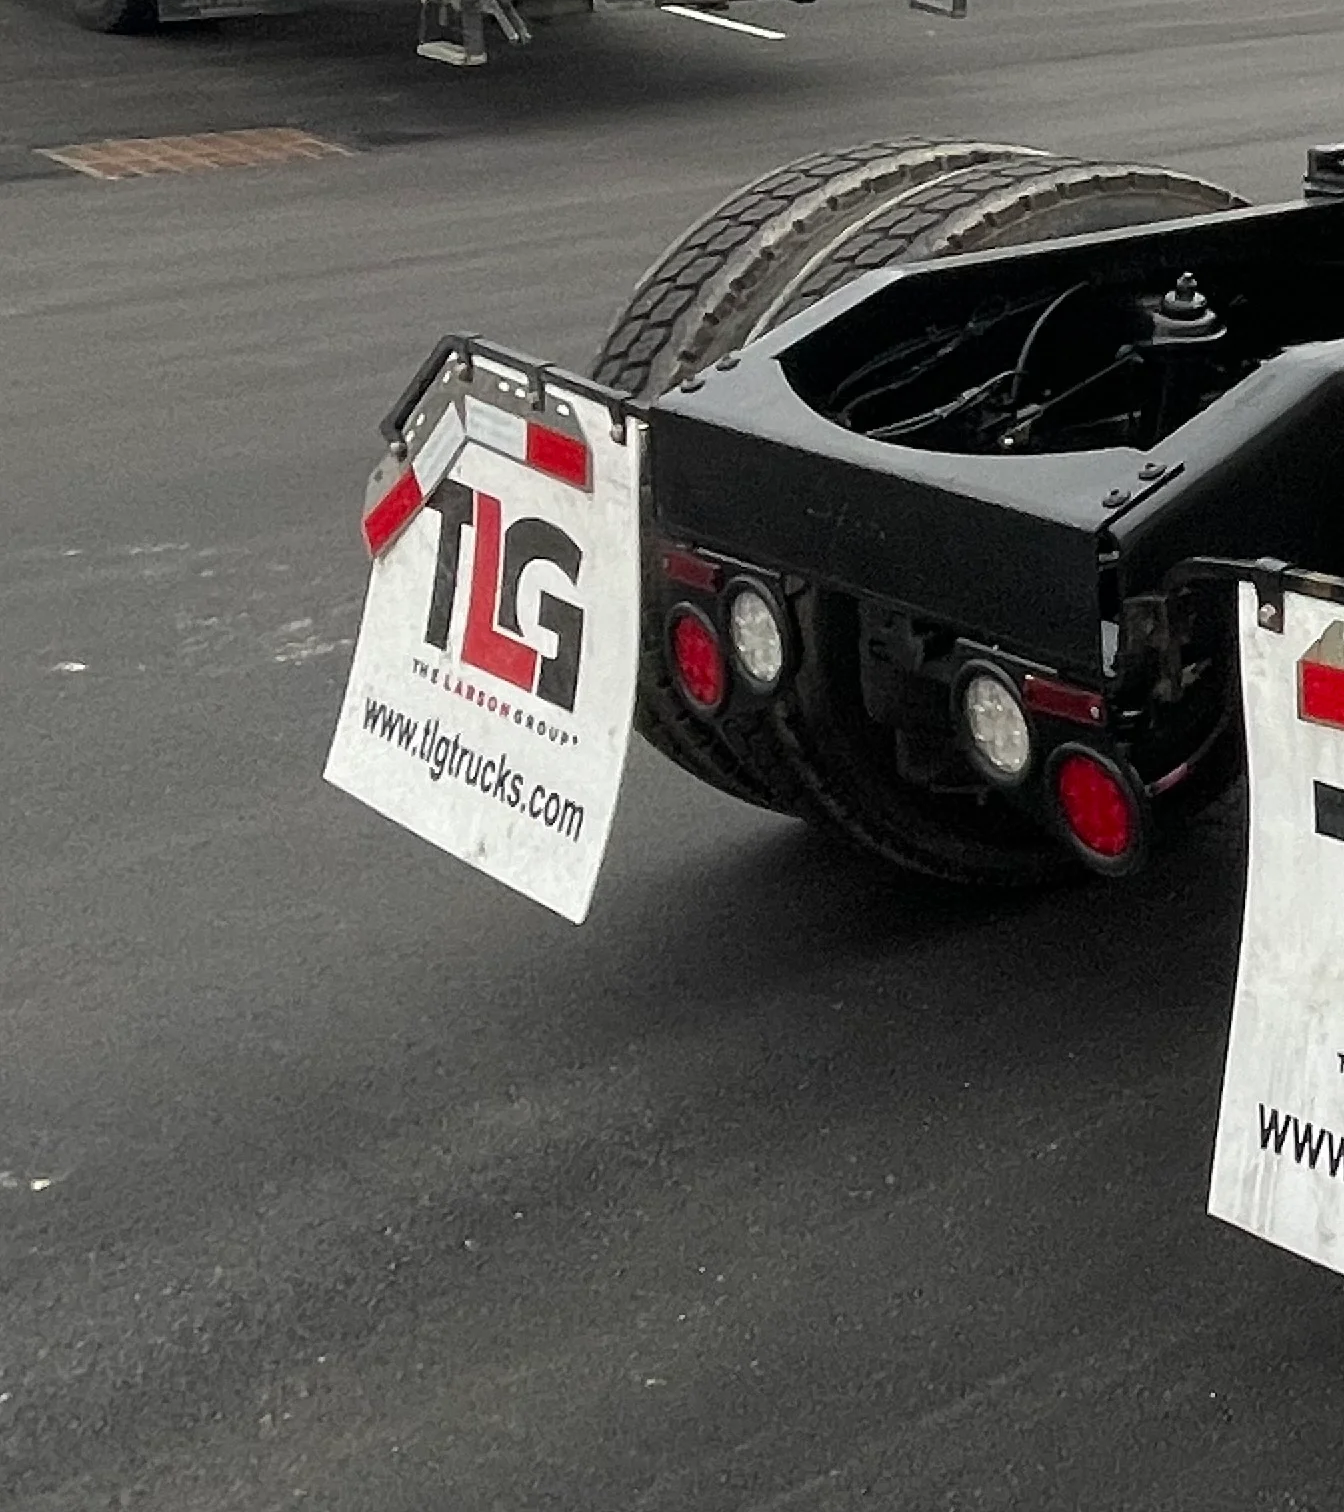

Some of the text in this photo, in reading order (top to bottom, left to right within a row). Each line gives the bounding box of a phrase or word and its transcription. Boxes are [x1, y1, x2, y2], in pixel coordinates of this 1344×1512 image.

[423, 479, 585, 714] TLG
[412, 658, 439, 685] THE
[443, 674, 511, 718] LARSON
[363, 696, 585, 843] www.tlgtrucks.com
